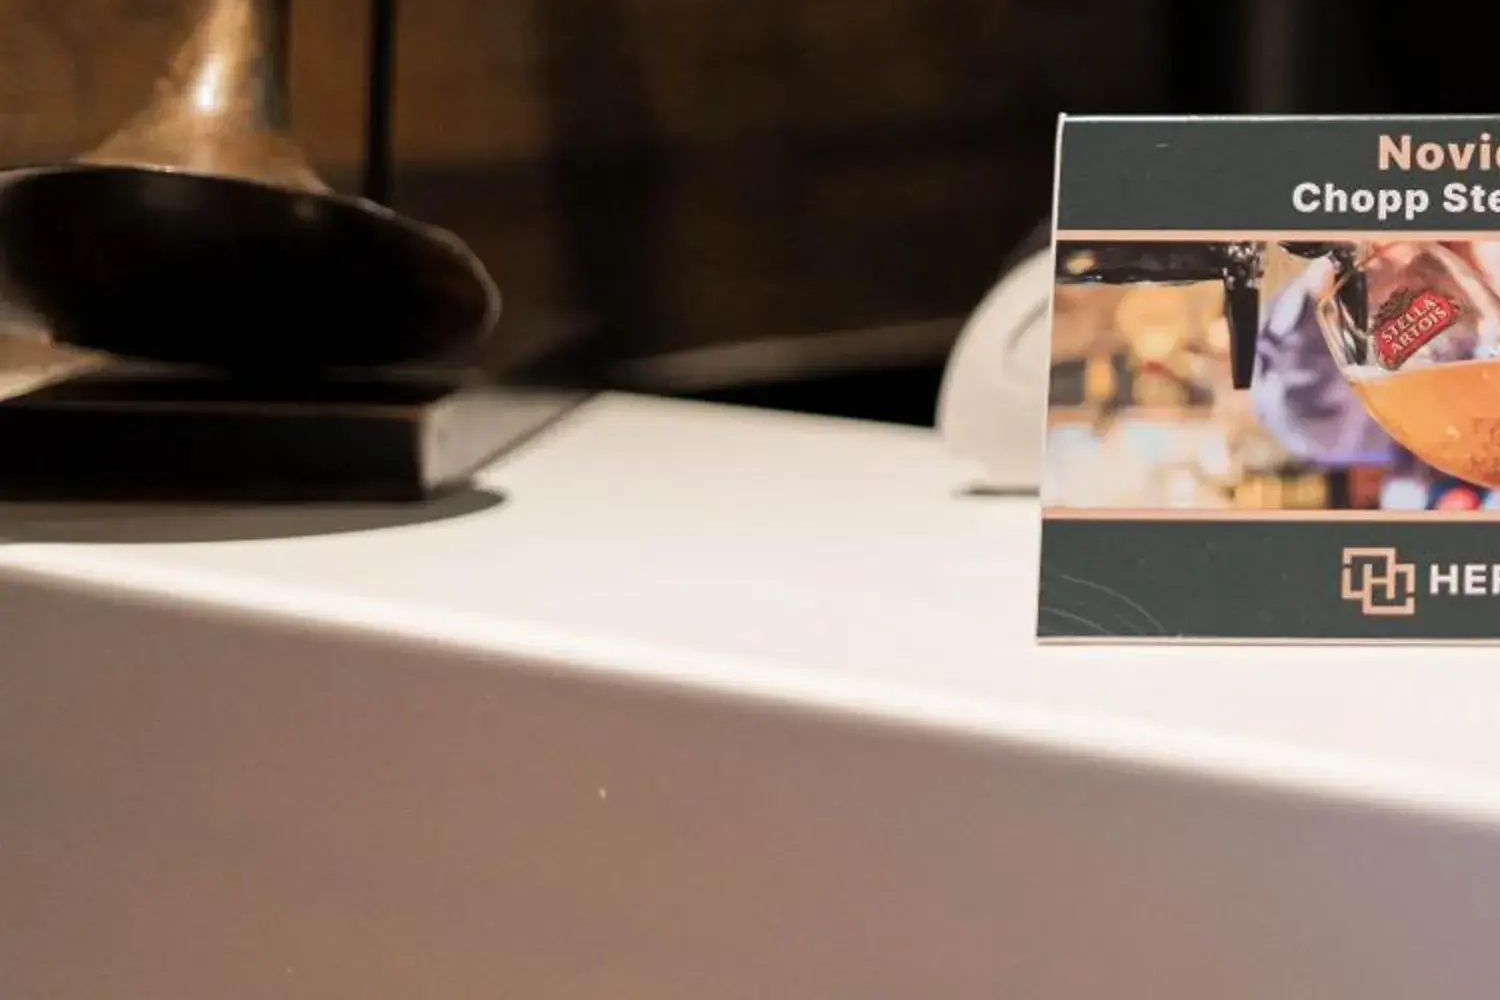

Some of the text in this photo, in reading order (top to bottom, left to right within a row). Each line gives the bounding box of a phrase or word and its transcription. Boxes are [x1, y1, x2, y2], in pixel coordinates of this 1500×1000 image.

[1291, 181, 1430, 221] Chopp
[1381, 299, 1437, 343] STELLA
[1391, 306, 1447, 355] ARTOIS
